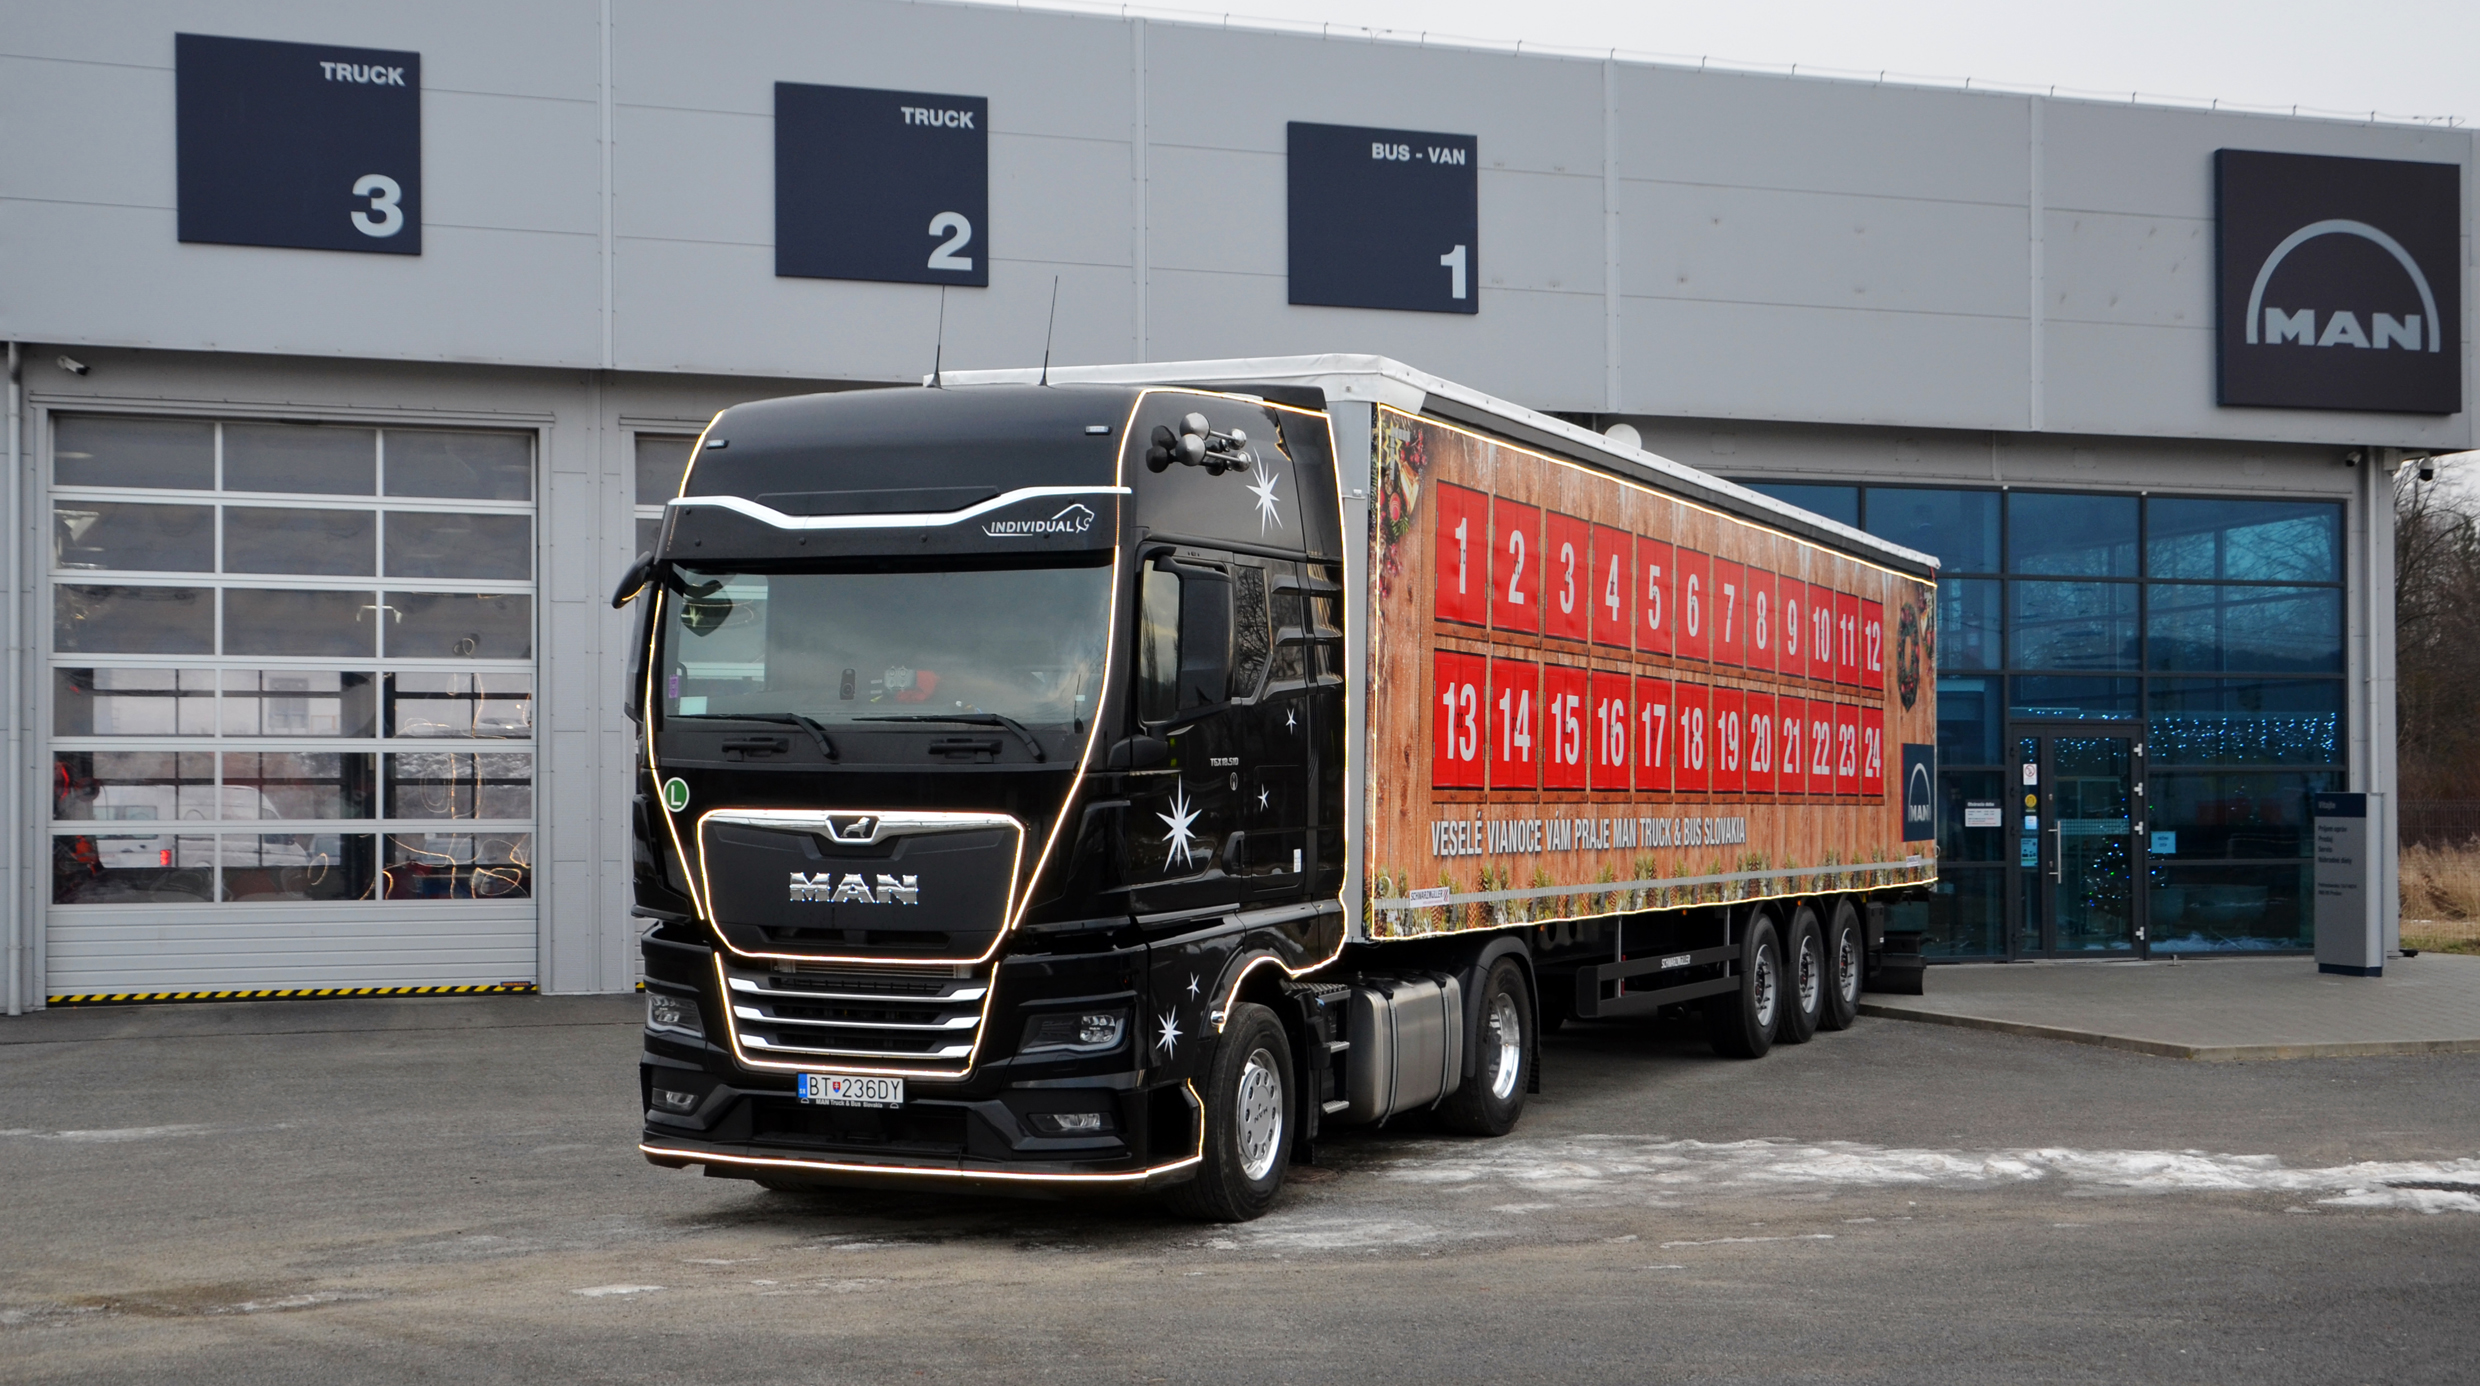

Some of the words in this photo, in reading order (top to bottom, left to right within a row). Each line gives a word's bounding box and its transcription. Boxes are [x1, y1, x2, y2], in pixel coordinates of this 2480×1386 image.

[320, 61, 405, 86] TRUCK
[901, 106, 974, 129] TRUCK
[1371, 142, 1411, 162] BUS
[1427, 146, 1466, 166] VAN
[351, 174, 403, 238] 3
[928, 211, 973, 271] 2
[1440, 244, 1467, 299] 1
[2265, 307, 2422, 351] MAN
[991, 521, 1074, 533] INDIVIDUAL
[1455, 517, 1467, 594] 1
[1509, 530, 1524, 604] 2
[1560, 542, 1574, 614] 3
[1606, 554, 1619, 621] 4
[1648, 564, 1661, 629] 5
[1687, 574, 1699, 637] 6
[1724, 583, 1735, 642] 7
[1756, 591, 1766, 649] 8
[1788, 599, 1797, 655] 9
[1813, 607, 1829, 662] 10
[1840, 614, 1854, 666] 11
[1866, 621, 1880, 671] 12
[1443, 682, 1476, 761] 13
[1500, 688, 1530, 762] 14
[1552, 693, 1579, 765] 15
[1598, 698, 1624, 766] 16
[1642, 703, 1665, 767] 17
[1681, 707, 1703, 770] 18
[1718, 711, 1738, 771] 19
[1751, 714, 1771, 772] 20
[1784, 718, 1800, 773] 21
[1813, 721, 1829, 775] 22
[1839, 724, 1855, 776] 23
[1865, 727, 1881, 777] 24
[671, 785, 682, 805] L
[1909, 804, 1930, 822] MAN
[1431, 811, 1483, 856] VESELÉ
[1487, 819, 1542, 854] VIANOCE
[1545, 810, 1571, 851] VÁM
[1575, 818, 1610, 850] PRAJE
[1613, 818, 1637, 848] MAN
[1639, 817, 1672, 847] TRUCK
[1674, 818, 1682, 846] &
[1684, 818, 1702, 846] BUS
[1704, 817, 1746, 845] SLOVAKIA
[789, 872, 918, 905] MAN
[810, 1076, 831, 1097] BT
[842, 1078, 900, 1100] 236DY
[831, 1099, 845, 1107] Truck
